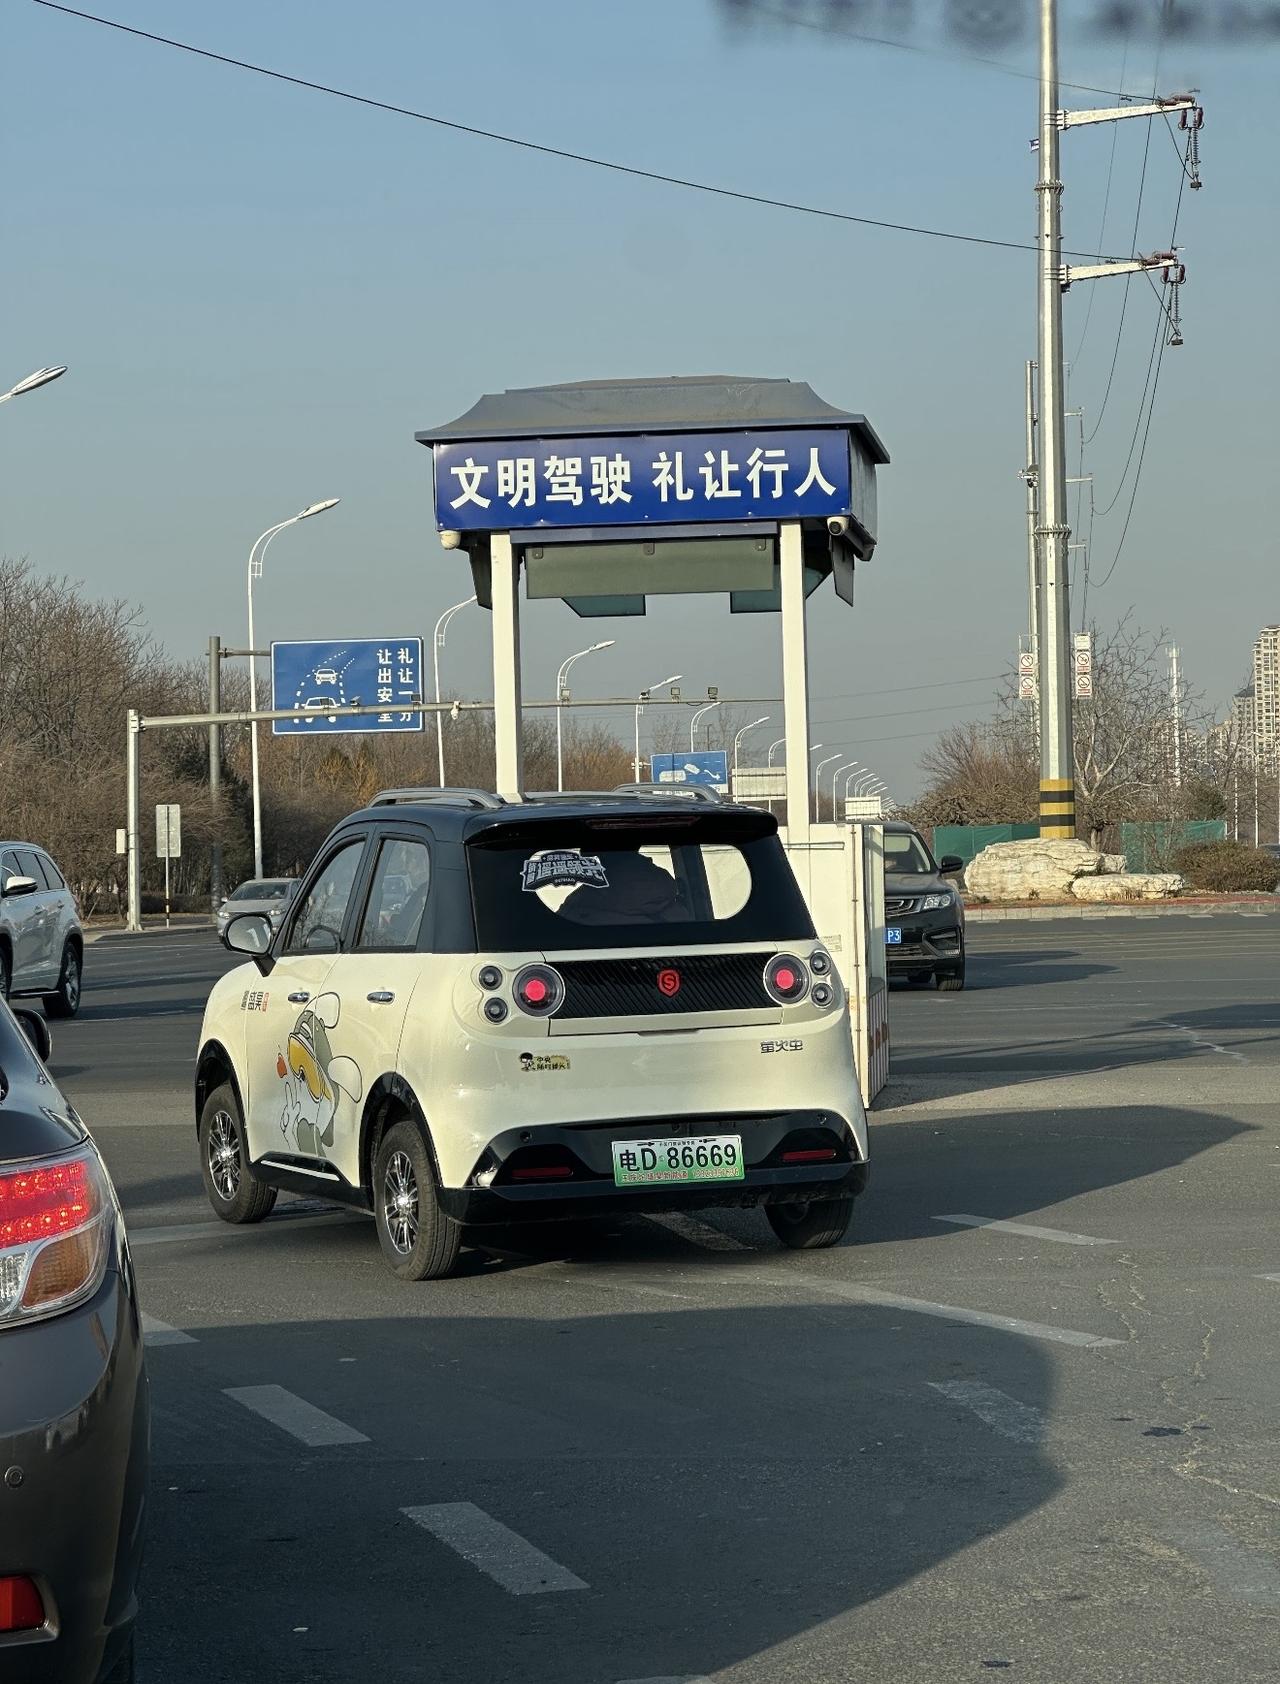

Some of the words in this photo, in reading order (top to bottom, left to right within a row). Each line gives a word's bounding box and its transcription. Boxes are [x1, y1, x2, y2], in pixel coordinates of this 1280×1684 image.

[450, 453, 633, 510] 文明驾驶
[652, 447, 837, 503] 礼让行人
[666, 1143, 737, 1169] 86669
